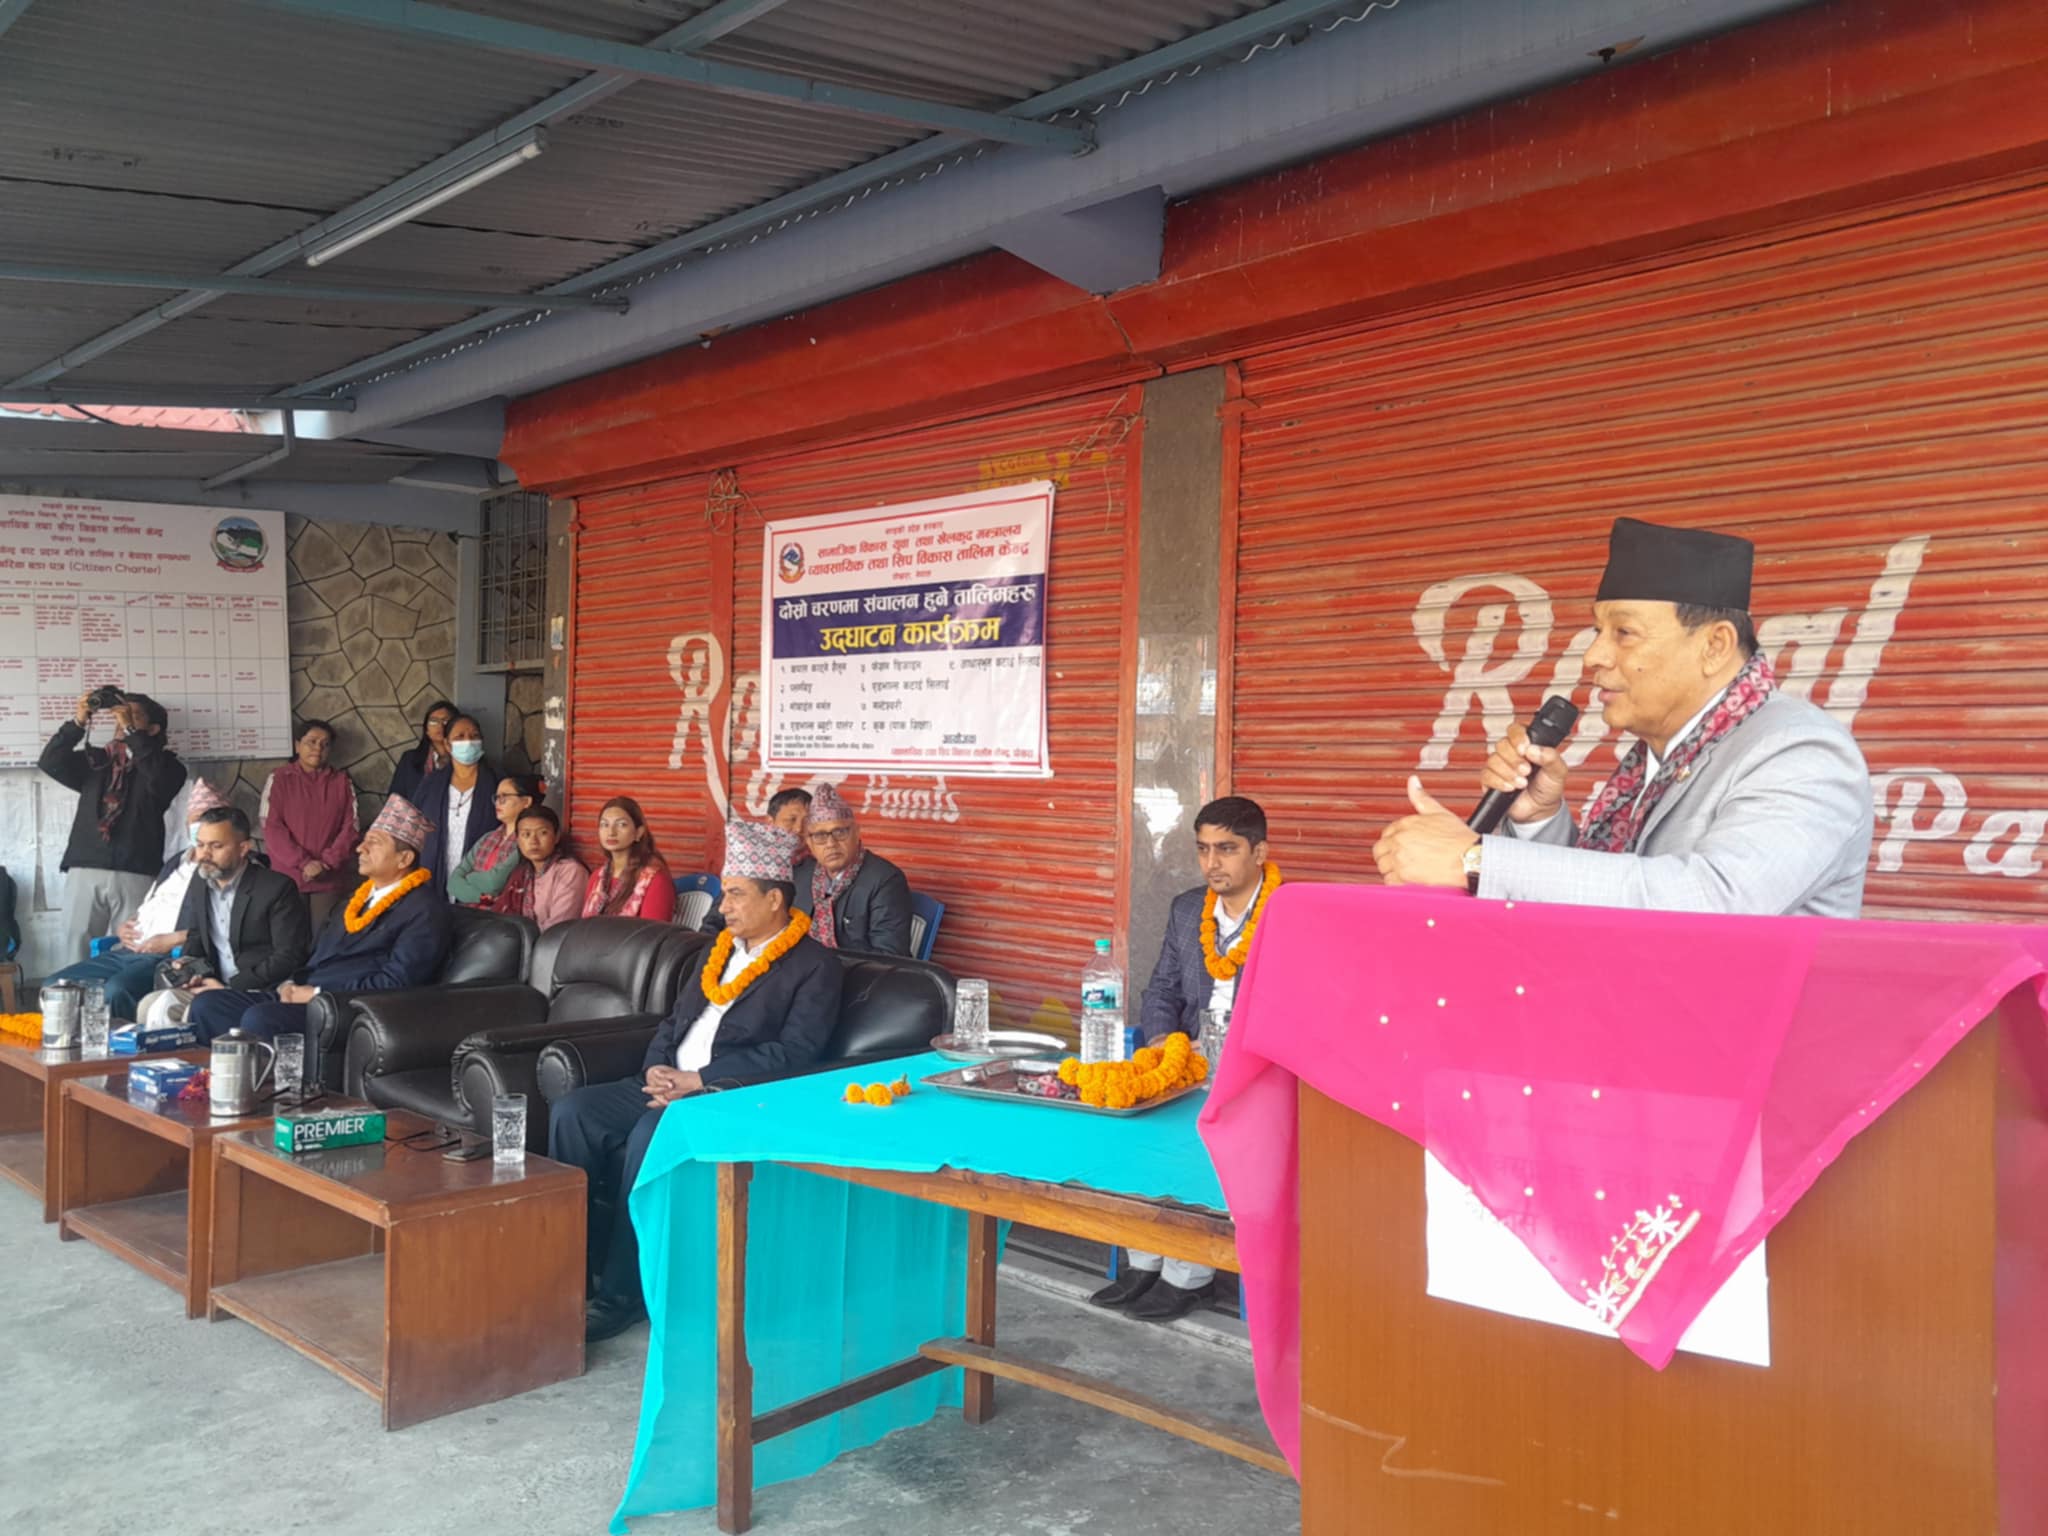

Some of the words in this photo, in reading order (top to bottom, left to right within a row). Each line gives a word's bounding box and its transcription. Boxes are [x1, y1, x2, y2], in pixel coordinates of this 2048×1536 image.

[69, 563, 112, 574] (Citizen
[115, 563, 162, 576] Charter)
[868, 557, 889, 570] तथा
[892, 552, 913, 568] सिप
[917, 549, 952, 565] विकास
[956, 543, 995, 561] तालिम
[811, 598, 859, 617] चरणमा
[863, 593, 919, 614] संचालन
[923, 585, 949, 612] हुने
[902, 614, 1002, 645] कार्यक्रम
[294, 1117, 366, 1141] PREMIER
